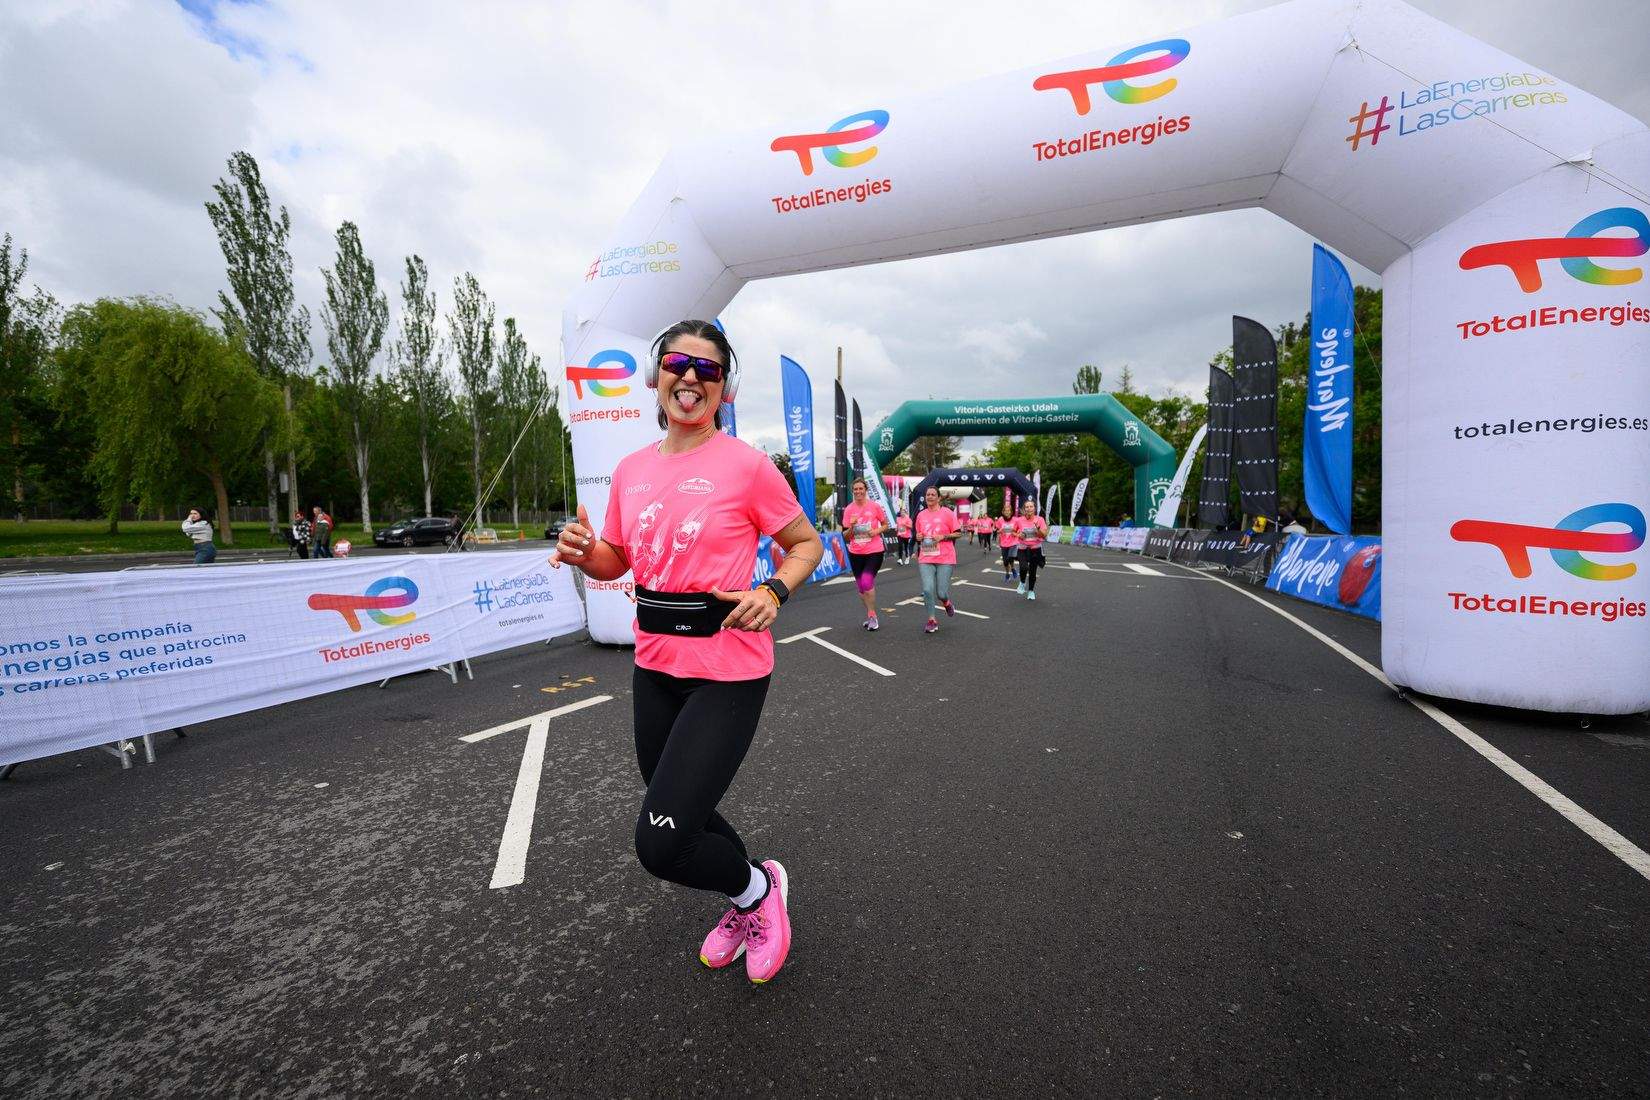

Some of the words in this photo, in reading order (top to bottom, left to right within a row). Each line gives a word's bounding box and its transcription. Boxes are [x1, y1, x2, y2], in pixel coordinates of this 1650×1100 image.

[1032, 114, 1191, 162] TotalEnergies
[771, 177, 891, 214] TotalEnergies
[1456, 302, 1650, 340] TotalEnergies
[1308, 328, 1351, 432] Marlene
[935, 416, 997, 426] Ayuntamiento
[999, 416, 1010, 424] de
[1012, 413, 1079, 424] Vitoria-Gasteiz
[954, 404, 1030, 414] Vitoria-Gasteizko
[1032, 403, 1058, 412] Udala
[789, 406, 811, 472] Marlene
[1454, 413, 1648, 440] totalenergies.es
[948, 473, 1005, 482] VOLVO
[1206, 540, 1236, 550] VOLVO
[1273, 537, 1340, 596] Marlene
[498, 613, 544, 628] totalenergies.es
[1448, 593, 1646, 622] TotalEnergies
[69, 635, 88, 647] la
[95, 622, 193, 641] compañía
[119, 646, 157, 660] que
[163, 632, 247, 655] patrocina
[319, 632, 431, 663] TotalEnergies
[13, 671, 110, 694] carreras
[116, 654, 213, 681] preferidas
